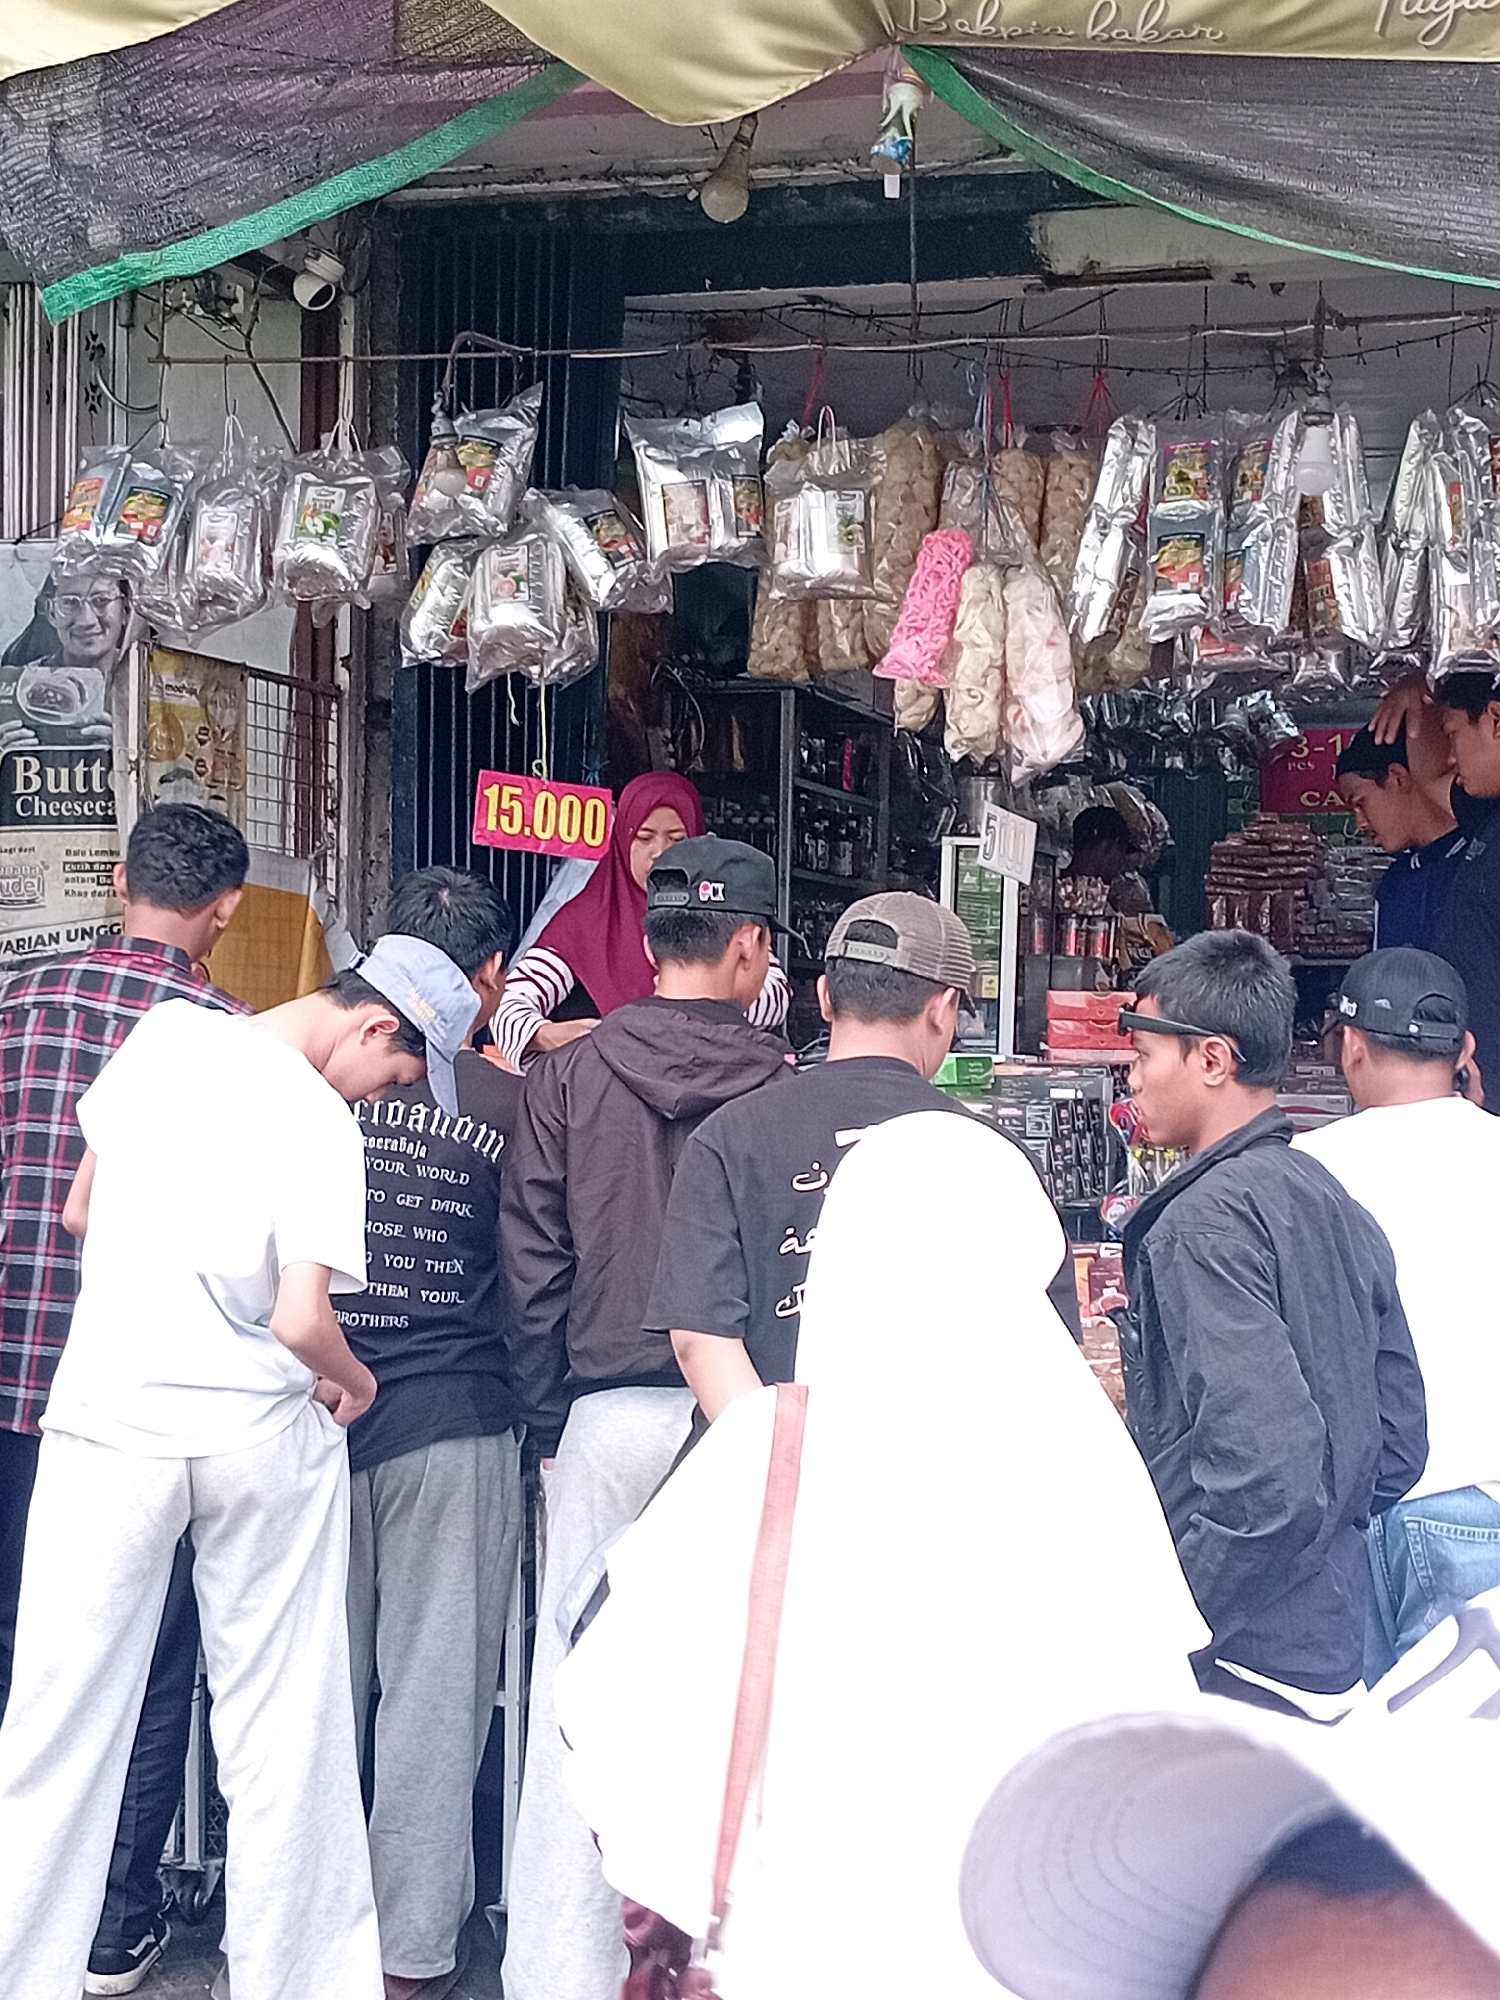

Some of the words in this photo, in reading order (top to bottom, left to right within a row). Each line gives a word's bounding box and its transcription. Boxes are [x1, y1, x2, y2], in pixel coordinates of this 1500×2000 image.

[483, 782, 606, 847] 15.000
[416, 1163, 471, 1186] WORLD
[396, 1193, 424, 1209] GET
[430, 1198, 475, 1219] DARK
[412, 1225, 449, 1244] WHO
[383, 1253, 417, 1271] YOU
[424, 1258, 465, 1276] THEN
[367, 1281, 410, 1300] THEM
[420, 1289, 466, 1305] YOUR
